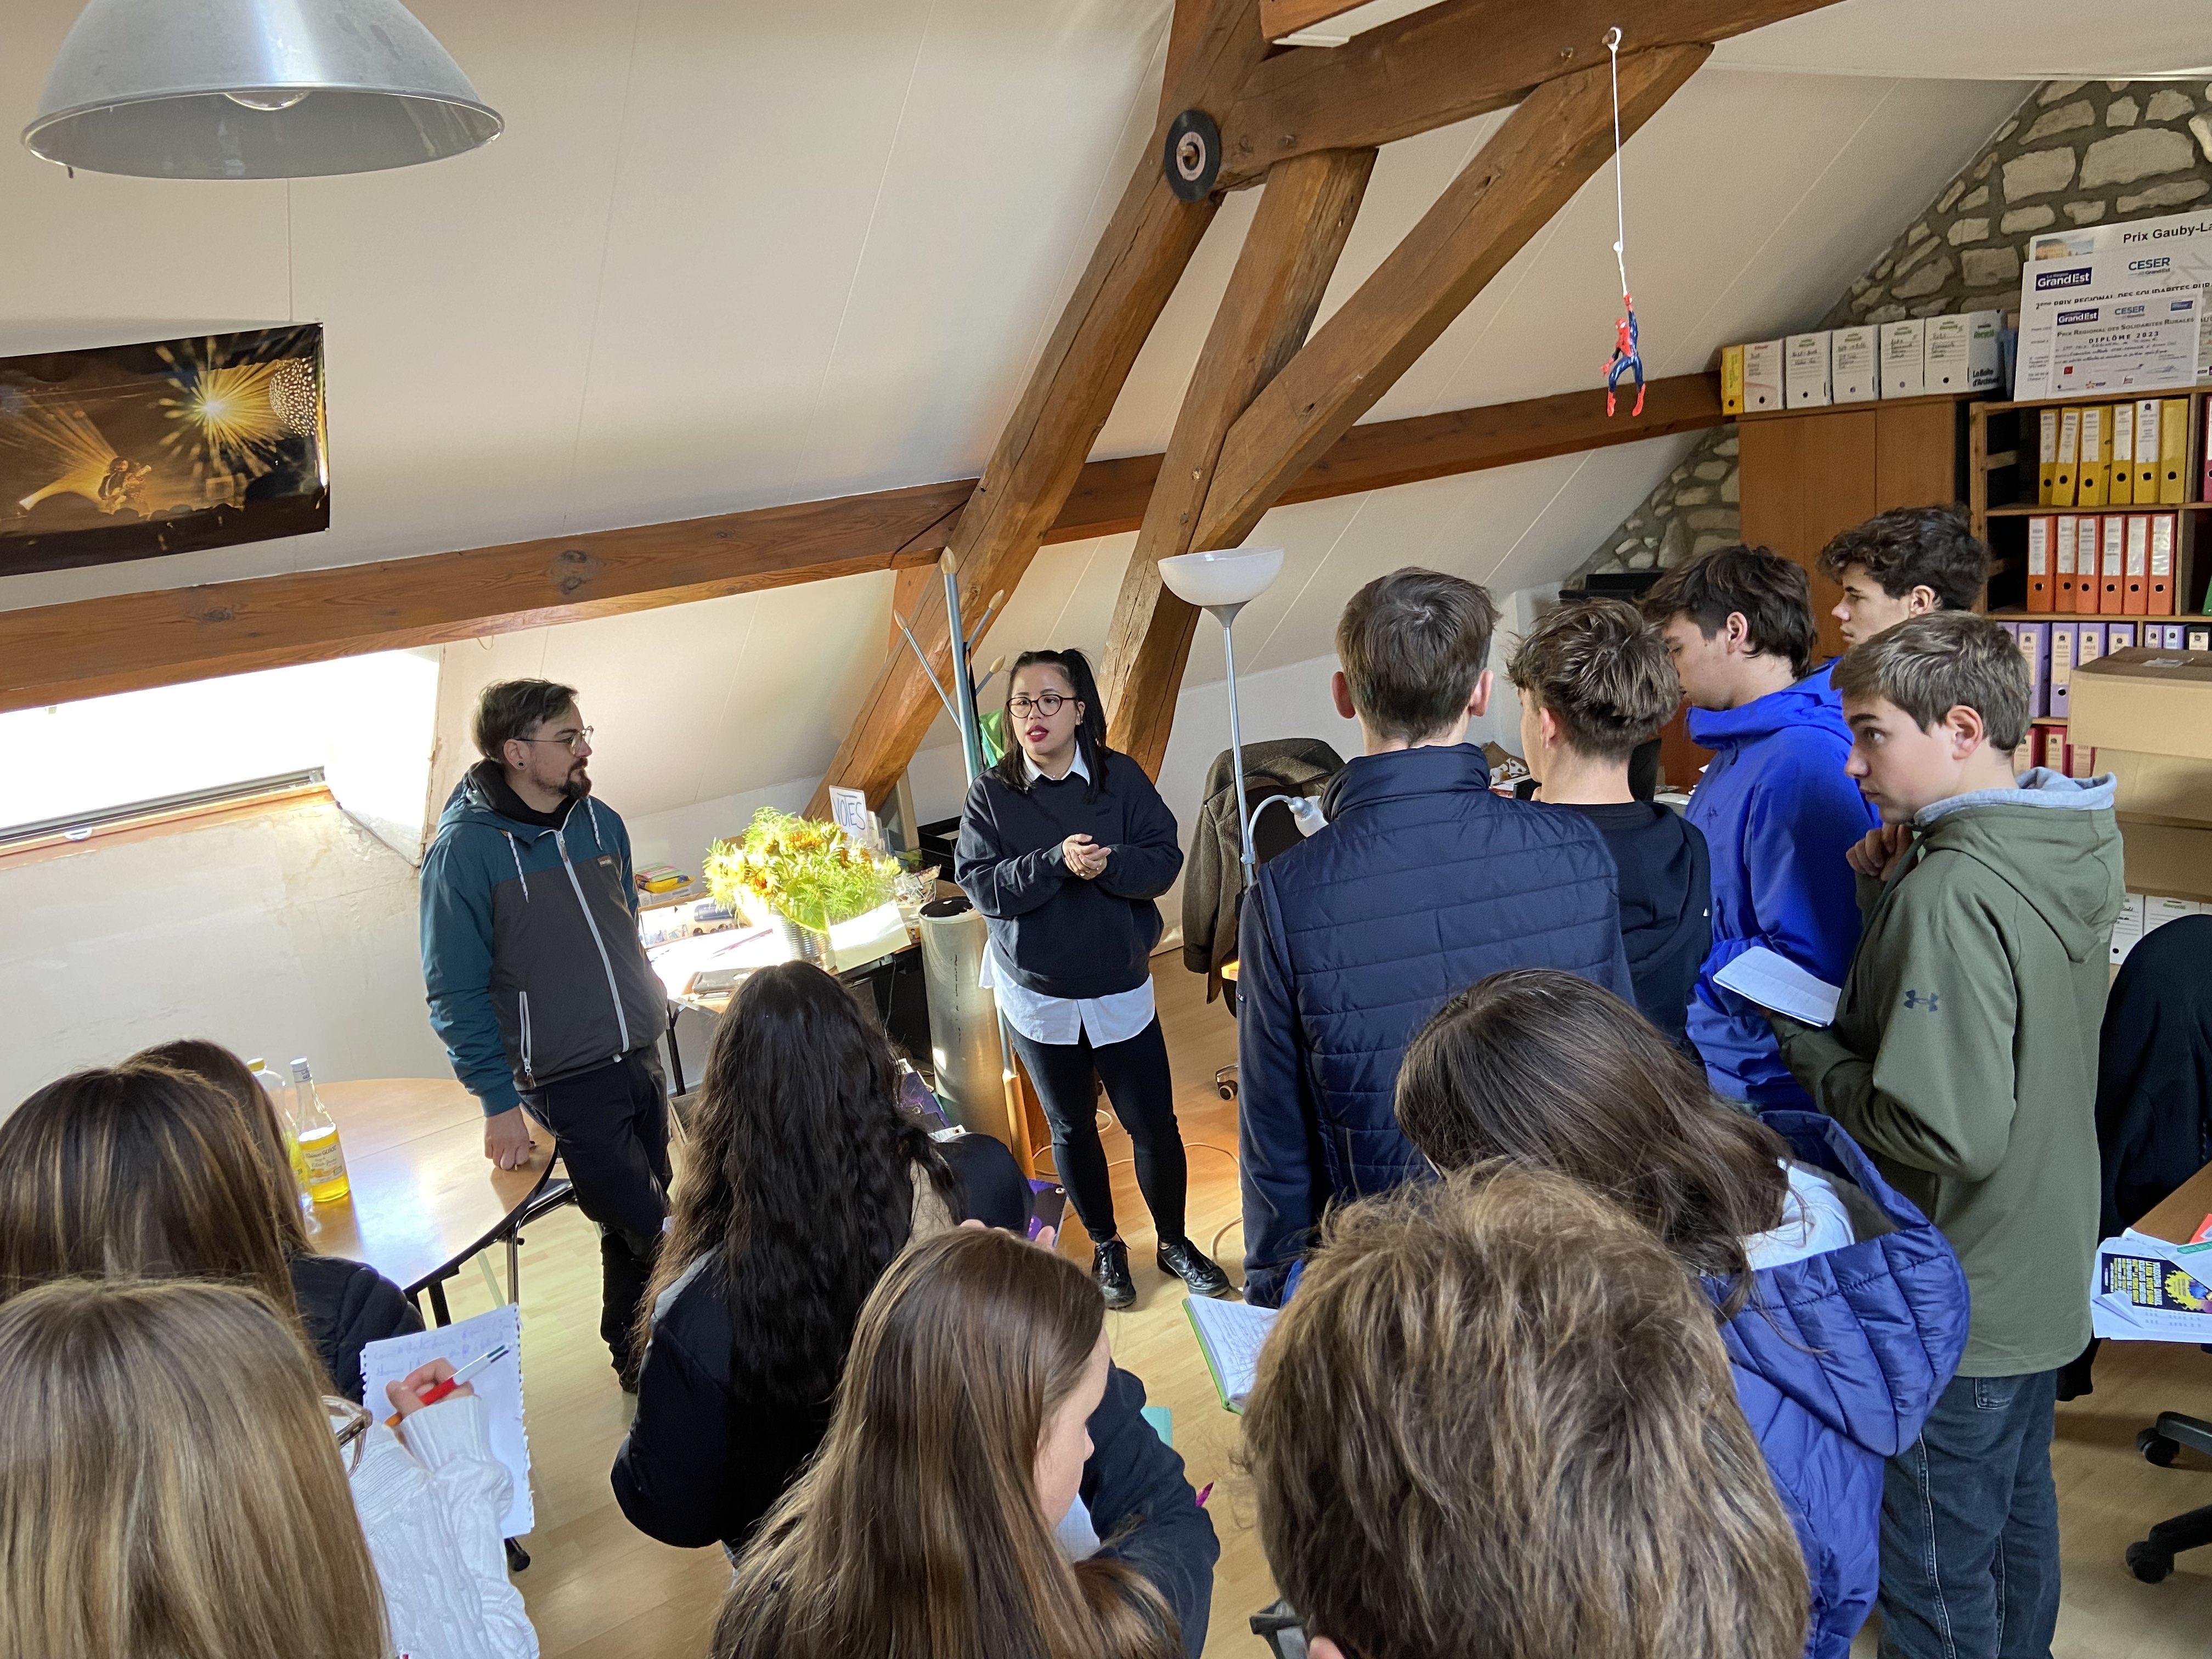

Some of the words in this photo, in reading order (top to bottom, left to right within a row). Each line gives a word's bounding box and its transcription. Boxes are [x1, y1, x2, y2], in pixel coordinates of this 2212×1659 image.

[2124, 232, 2148, 243] Prix
[2129, 257, 2170, 270] CESER
[2115, 306, 2145, 315] CESER
[832, 793, 865, 830] VOTES
